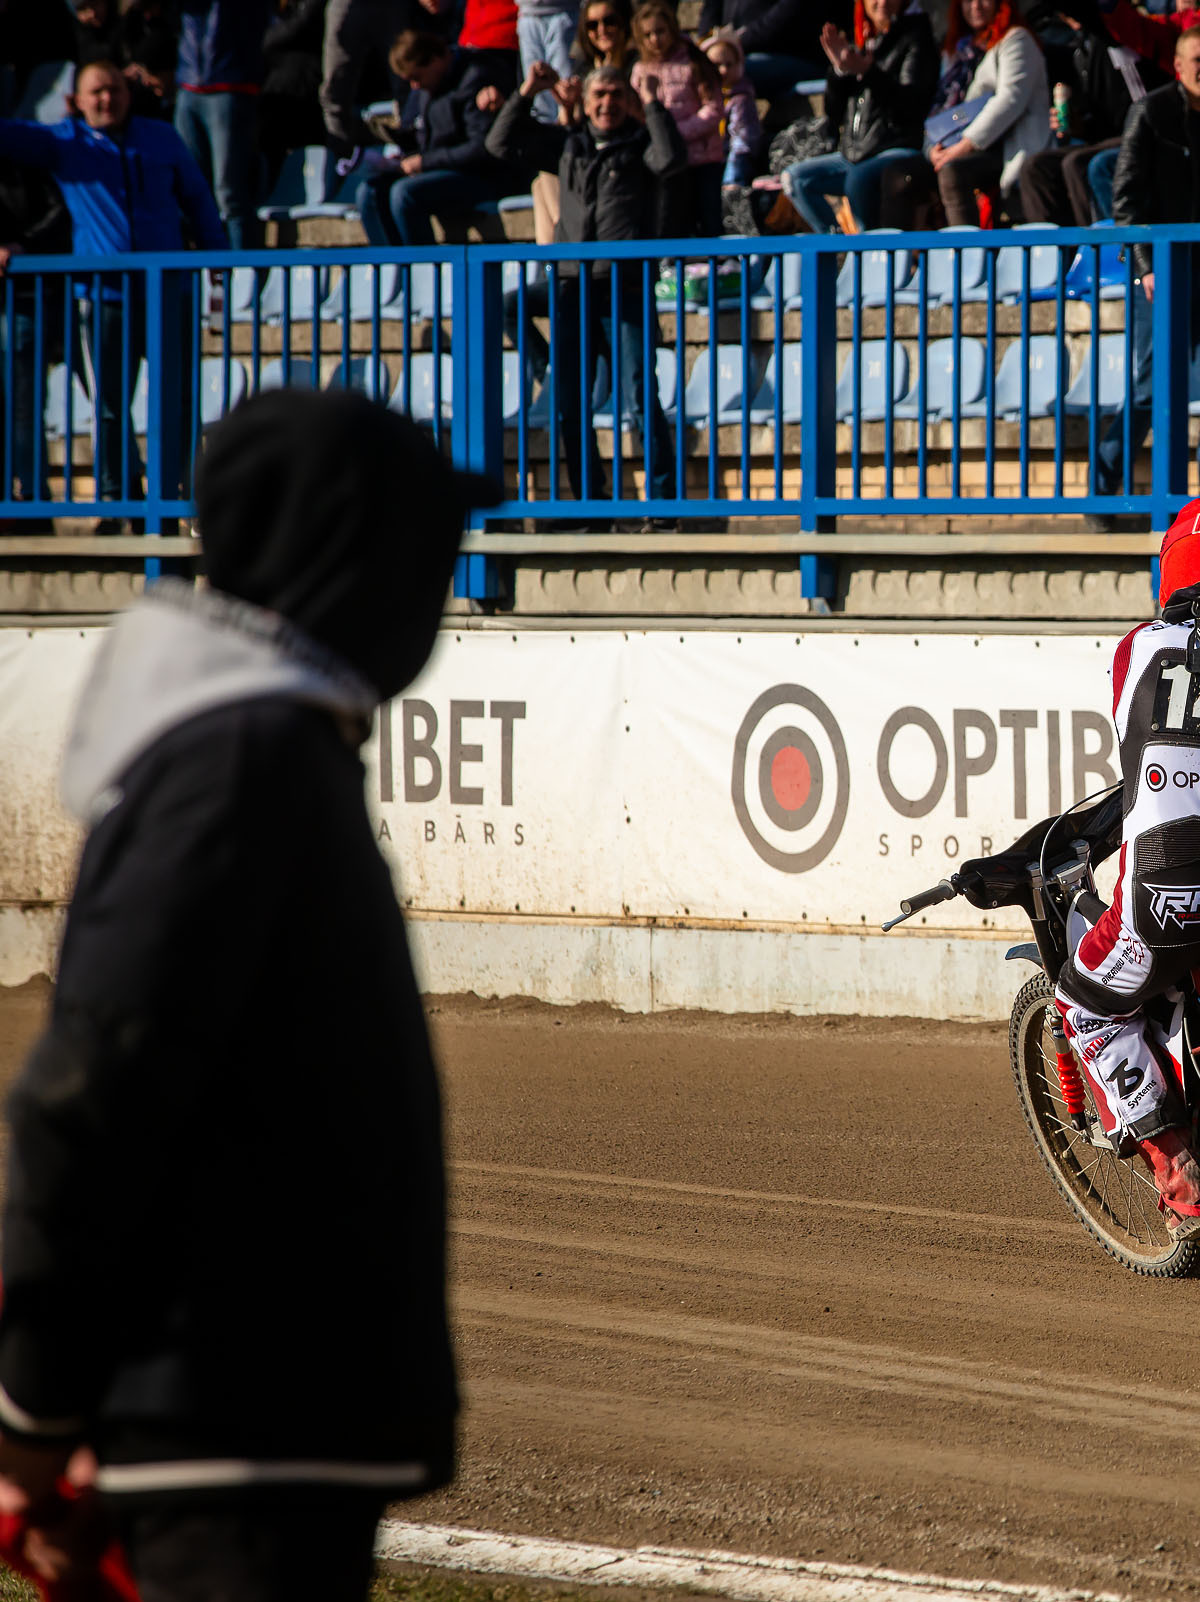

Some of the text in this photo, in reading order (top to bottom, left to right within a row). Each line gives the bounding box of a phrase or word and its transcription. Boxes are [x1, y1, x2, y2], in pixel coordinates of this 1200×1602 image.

[379, 698, 527, 806] IBET
[877, 705, 1119, 820] OPTIB
[424, 814, 525, 846] BĀRS
[878, 833, 994, 858] SPOR
[1127, 1079, 1157, 1110] Systems
